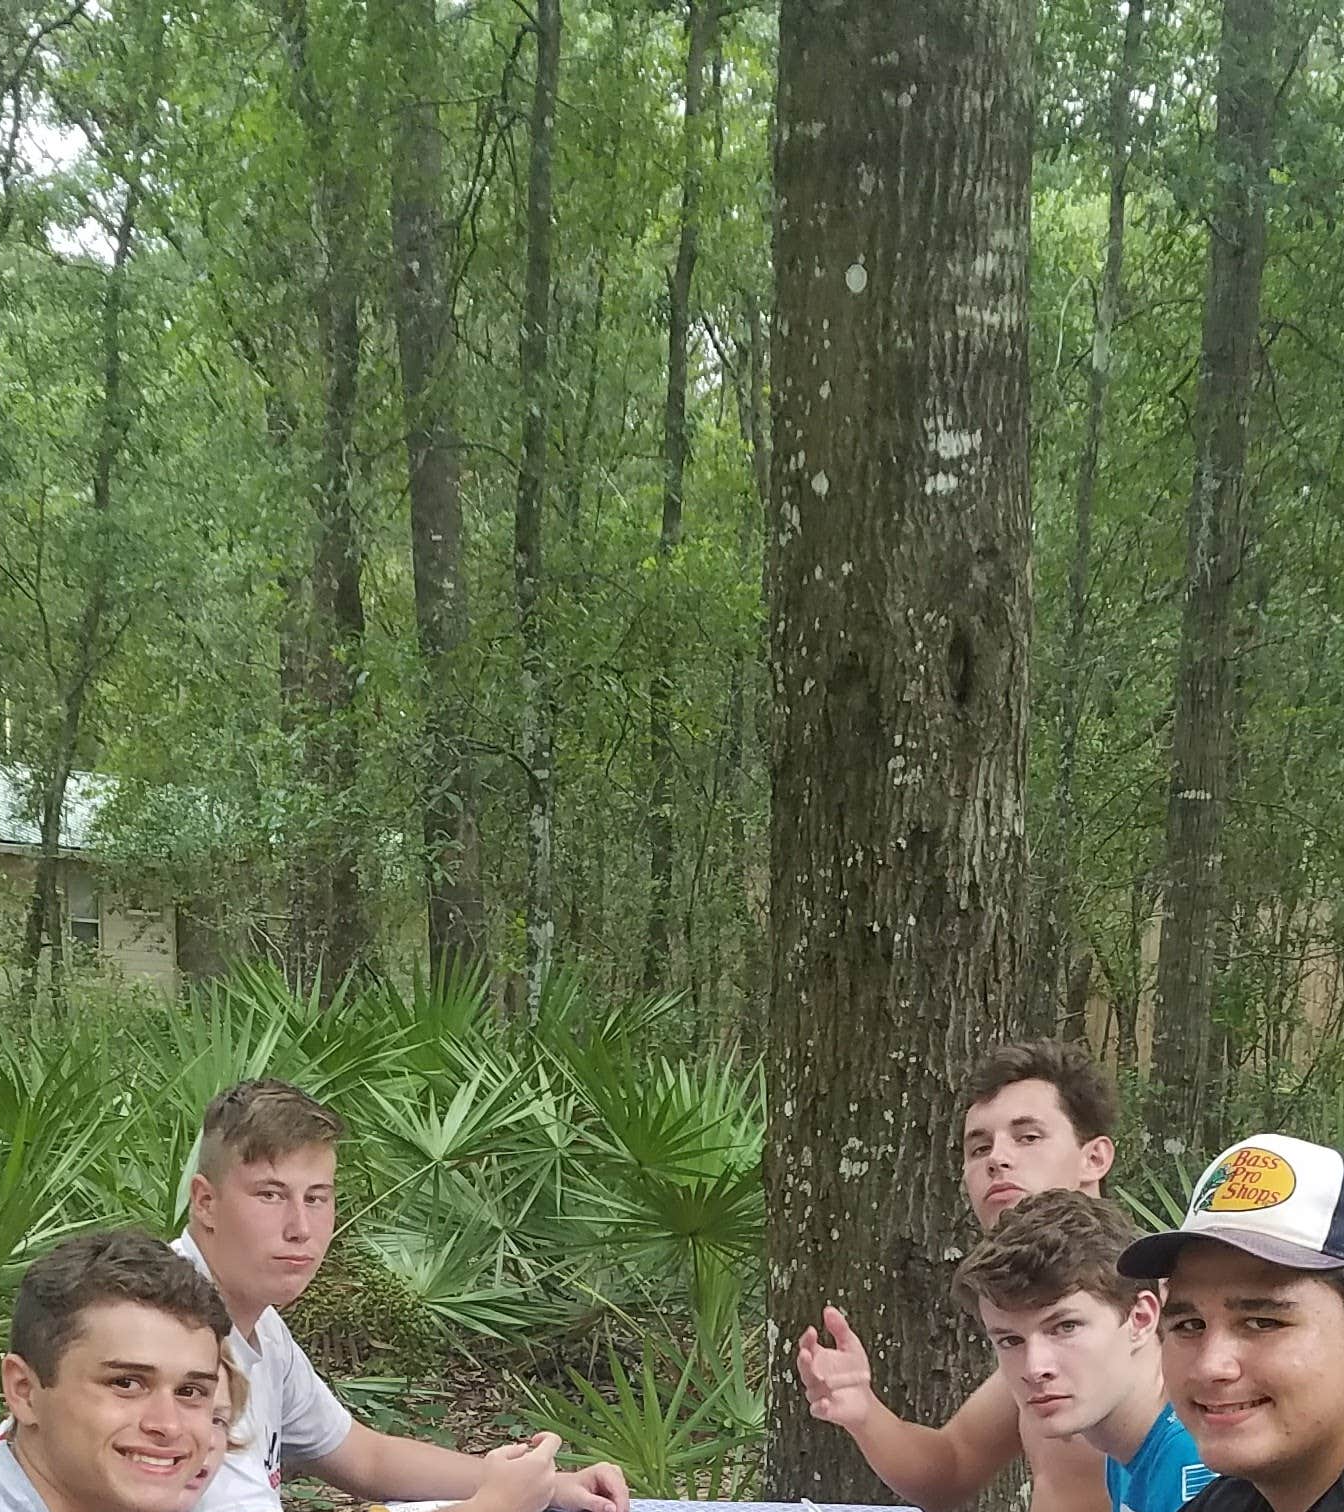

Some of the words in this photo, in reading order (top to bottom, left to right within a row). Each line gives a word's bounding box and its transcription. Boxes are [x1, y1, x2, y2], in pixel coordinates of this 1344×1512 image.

[1232, 1150, 1281, 1170] Bass
[1228, 1166, 1262, 1184] Pro
[1221, 1182, 1281, 1205] Shops
